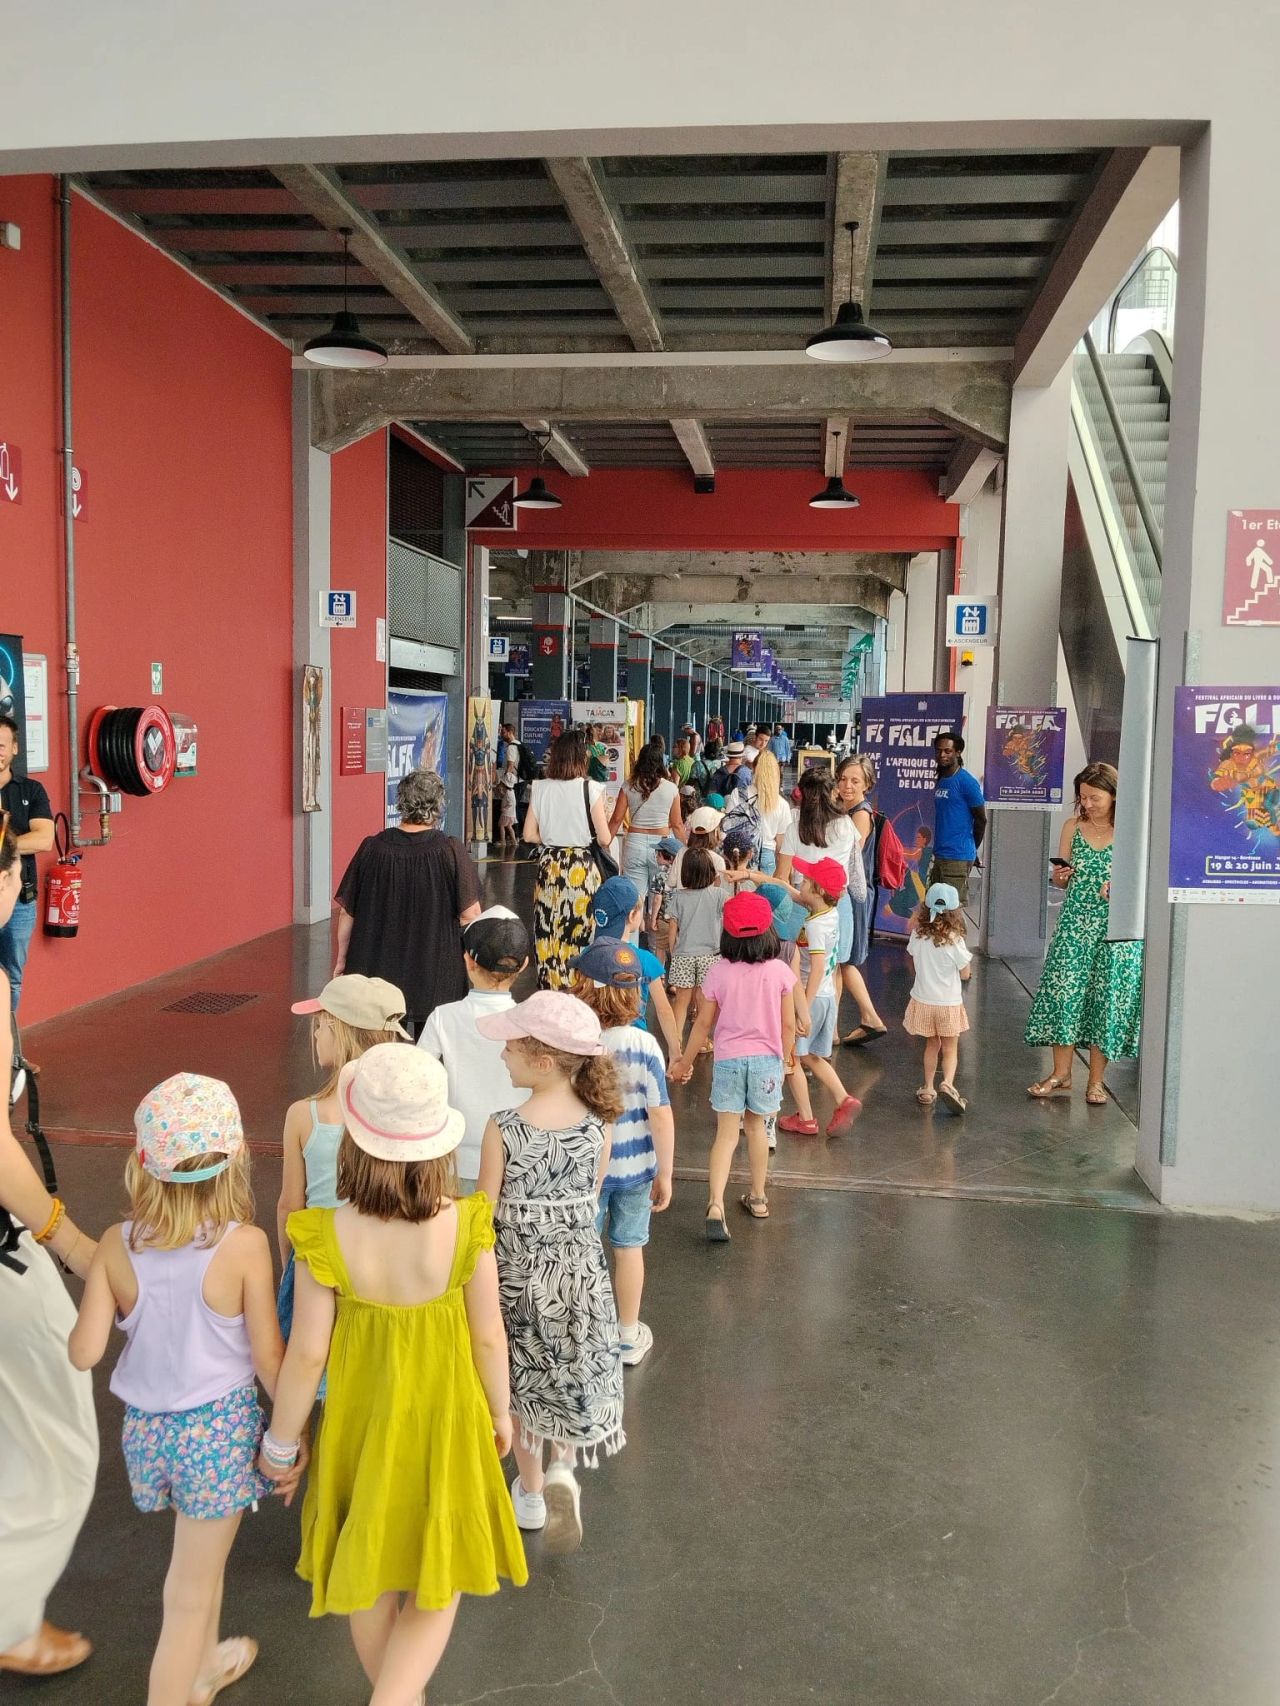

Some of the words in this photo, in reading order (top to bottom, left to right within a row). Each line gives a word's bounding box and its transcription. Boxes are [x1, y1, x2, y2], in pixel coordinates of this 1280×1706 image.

[1242, 519, 1263, 530] 1er
[886, 757, 928, 768] L'AFRIQUE
[899, 780, 910, 788] DE
[911, 780, 922, 789] LA
[923, 780, 935, 790] BD
[1210, 862, 1222, 871] 19
[1224, 861, 1233, 869] &
[1250, 861, 1272, 871] juin
